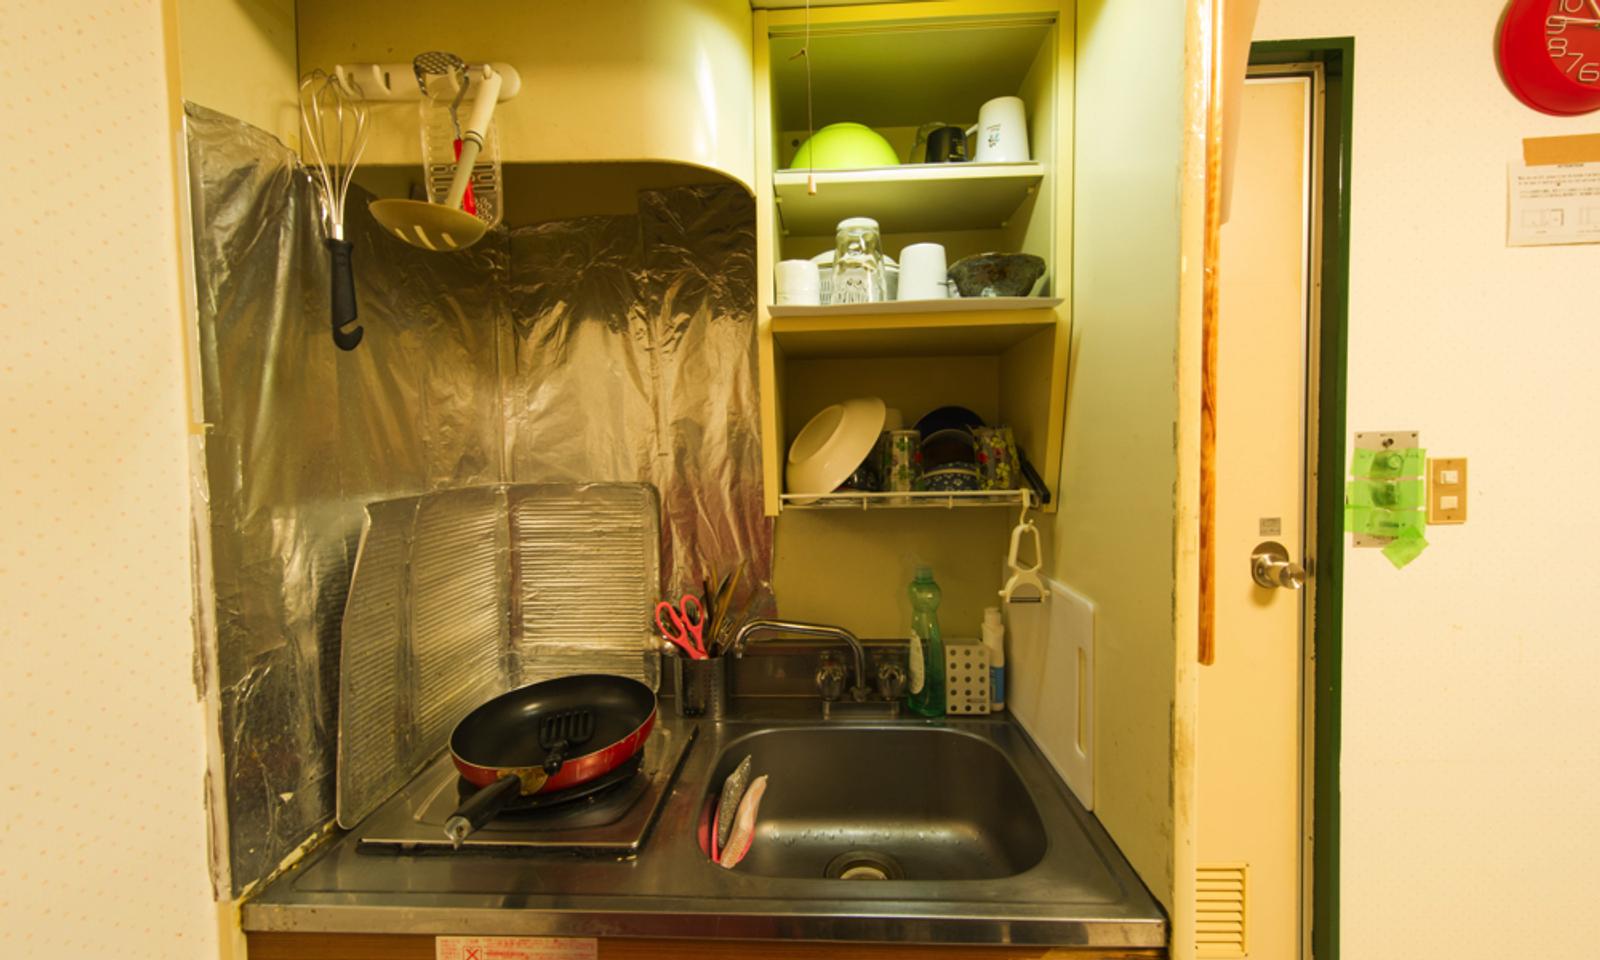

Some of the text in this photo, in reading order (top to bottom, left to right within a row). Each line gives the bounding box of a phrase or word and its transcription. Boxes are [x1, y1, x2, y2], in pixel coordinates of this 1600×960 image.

[1546, 15, 1567, 34] 9
[1547, 38, 1568, 57] 8
[1566, 53, 1584, 73] 7
[1579, 62, 1600, 82] 6
